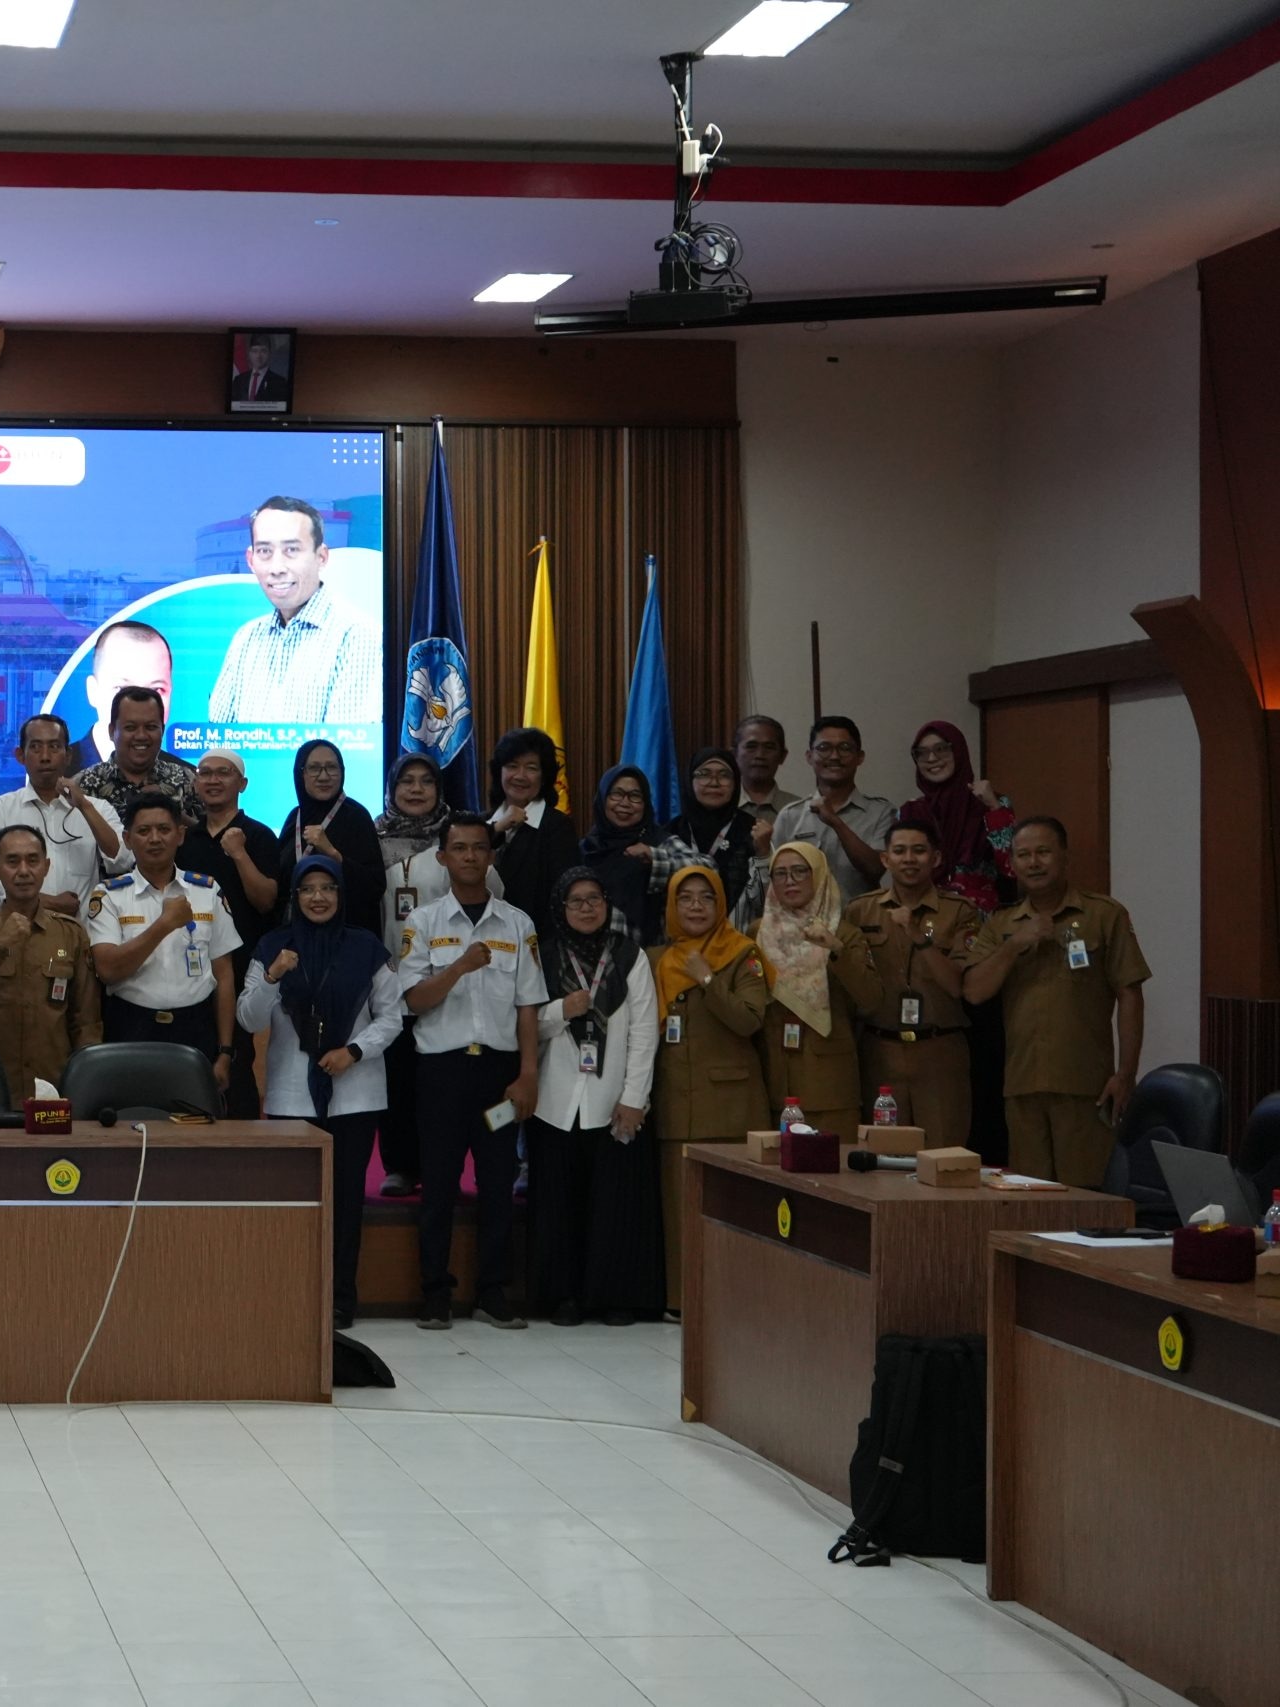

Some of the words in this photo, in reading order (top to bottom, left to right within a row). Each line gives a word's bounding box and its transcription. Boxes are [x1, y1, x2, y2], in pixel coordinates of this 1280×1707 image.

[174, 727, 204, 741] Prof.
[206, 728, 222, 741] M.
[173, 740, 203, 750] Dekan
